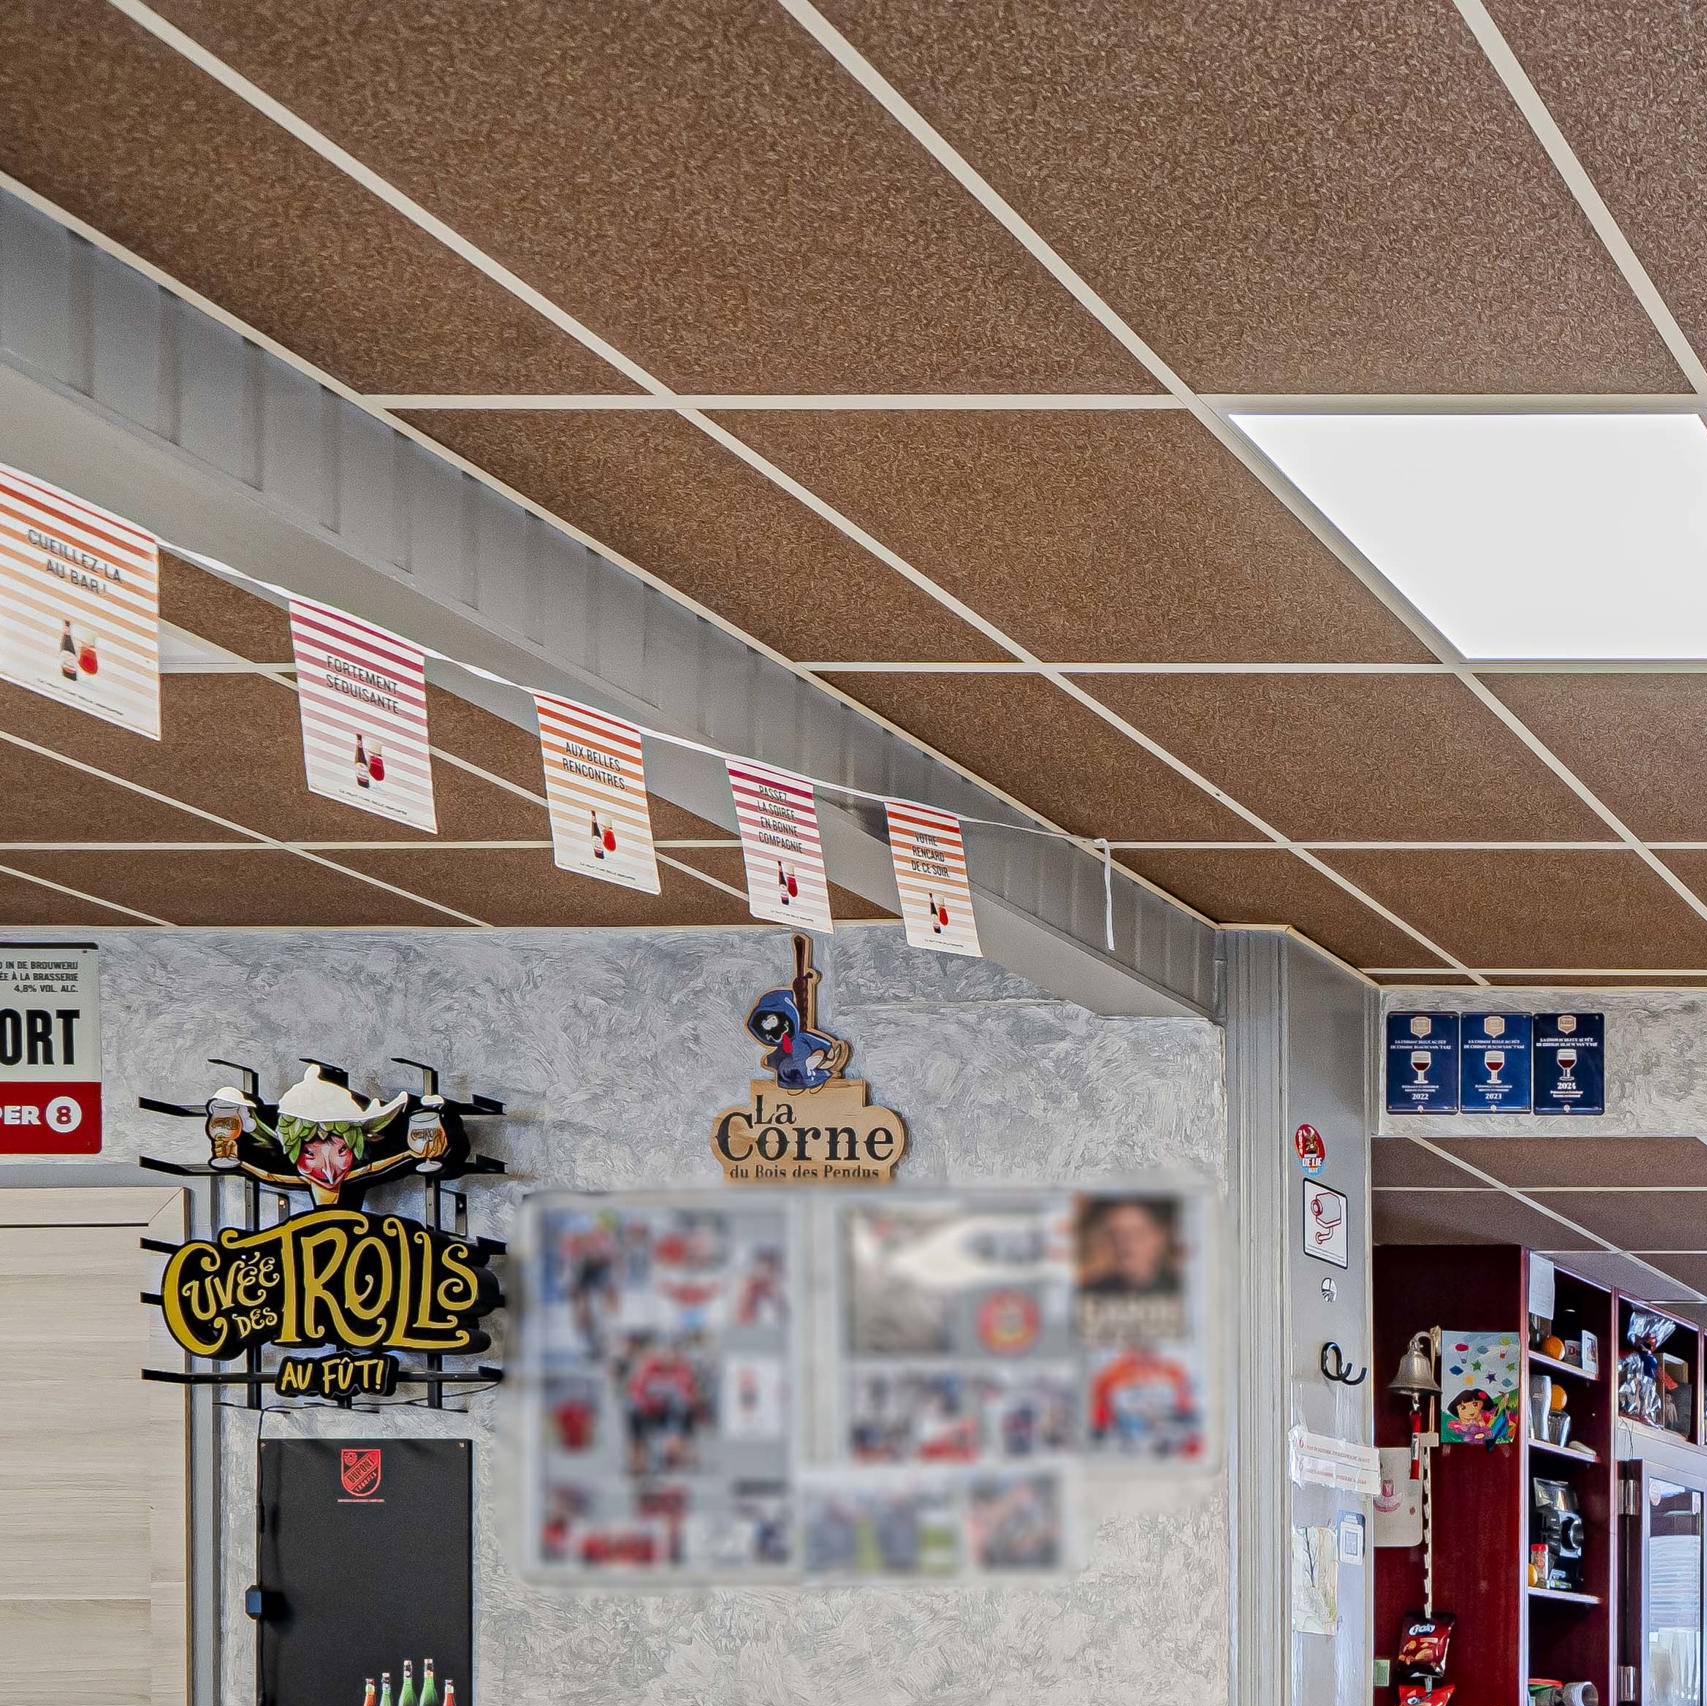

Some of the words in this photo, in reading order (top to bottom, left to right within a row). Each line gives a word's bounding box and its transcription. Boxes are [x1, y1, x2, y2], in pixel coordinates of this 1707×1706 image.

[27, 528, 122, 582] CUEILLEZ-LA
[46, 558, 65, 580] AU
[326, 655, 399, 695] FORTEMENT
[325, 672, 400, 715] SÉDUISANTE
[565, 742, 585, 760] AUX
[587, 748, 621, 772] BELLES
[758, 784, 787, 802] PASSEZ
[757, 800, 769, 813] LA
[760, 816, 772, 830] EN
[772, 819, 799, 837] BONNE
[758, 831, 803, 854] COMPAGNIE
[914, 831, 938, 847] VOTRE
[912, 846, 945, 863] RENCARD
[911, 859, 921, 872] DE
[921, 861, 932, 874] CE
[5, 961, 15, 970] IN
[17, 961, 28, 970] DE
[20, 973, 31, 981] LA
[33, 973, 79, 981] BRASSERIE
[55, 1105, 72, 1126] 8
[754, 1095, 796, 1125] La
[715, 1111, 894, 1162] Corne
[730, 1164, 749, 1180] du
[755, 1165, 786, 1180] Bois
[792, 1164, 818, 1180] des
[823, 1165, 880, 1180] Pendus
[281, 1363, 312, 1391] AU
[322, 1357, 382, 1394] FÛT!
